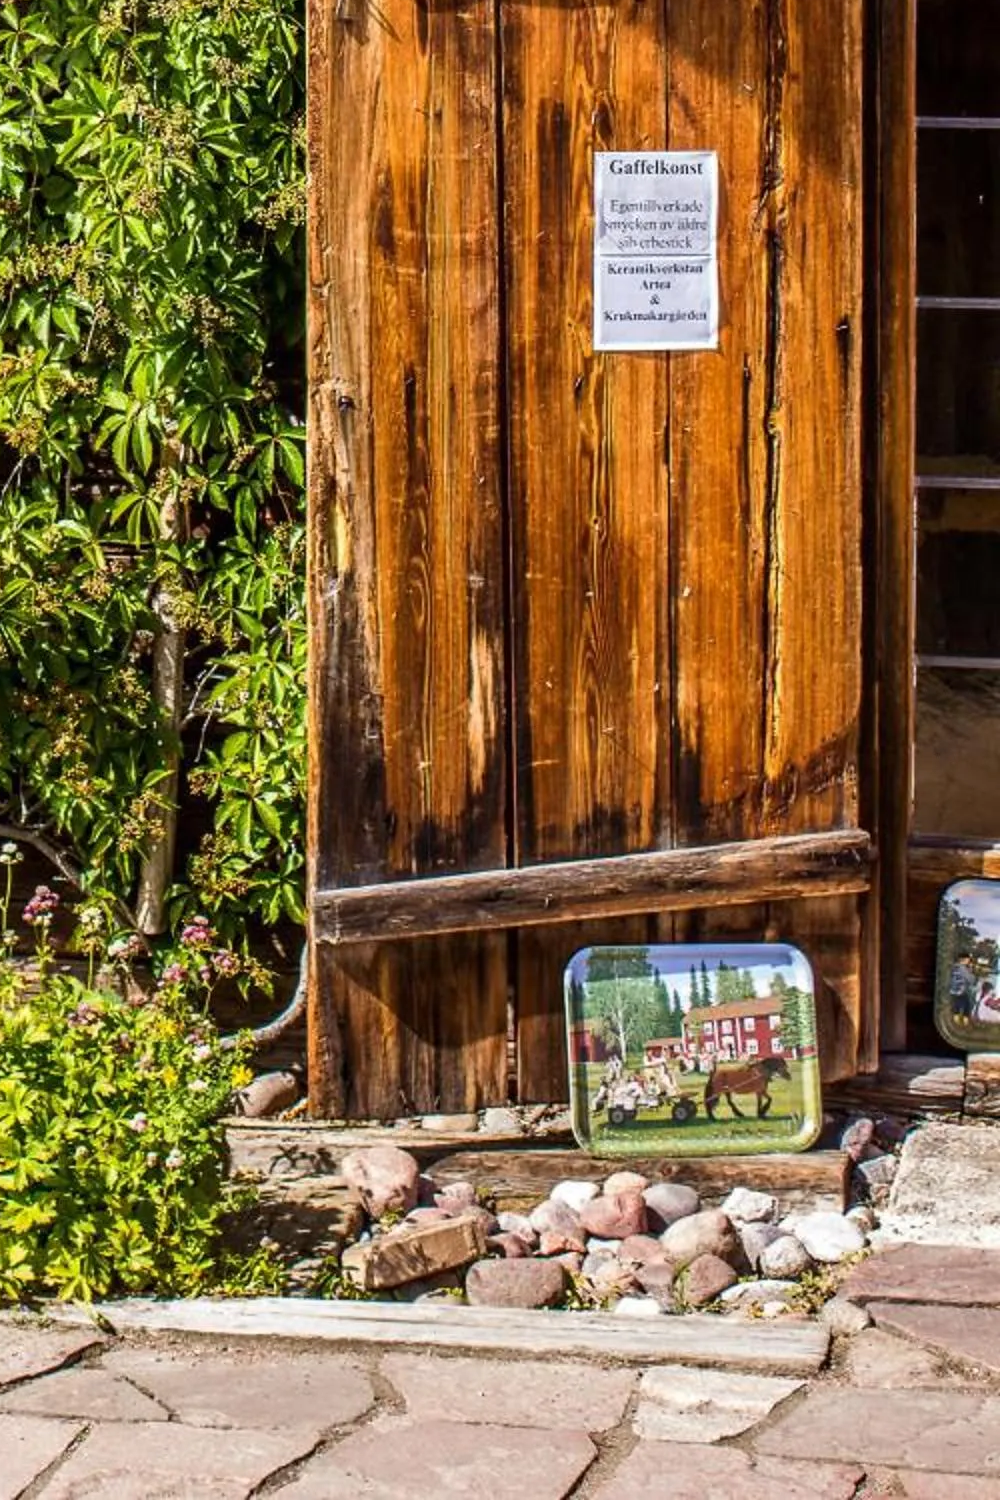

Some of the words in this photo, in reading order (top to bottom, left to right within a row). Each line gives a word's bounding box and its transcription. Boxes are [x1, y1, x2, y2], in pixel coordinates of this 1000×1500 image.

[609, 159, 703, 175] Gaffelkonst
[610, 199, 703, 214] Egentillverkade
[660, 221, 674, 231] av
[649, 294, 660, 305] &
